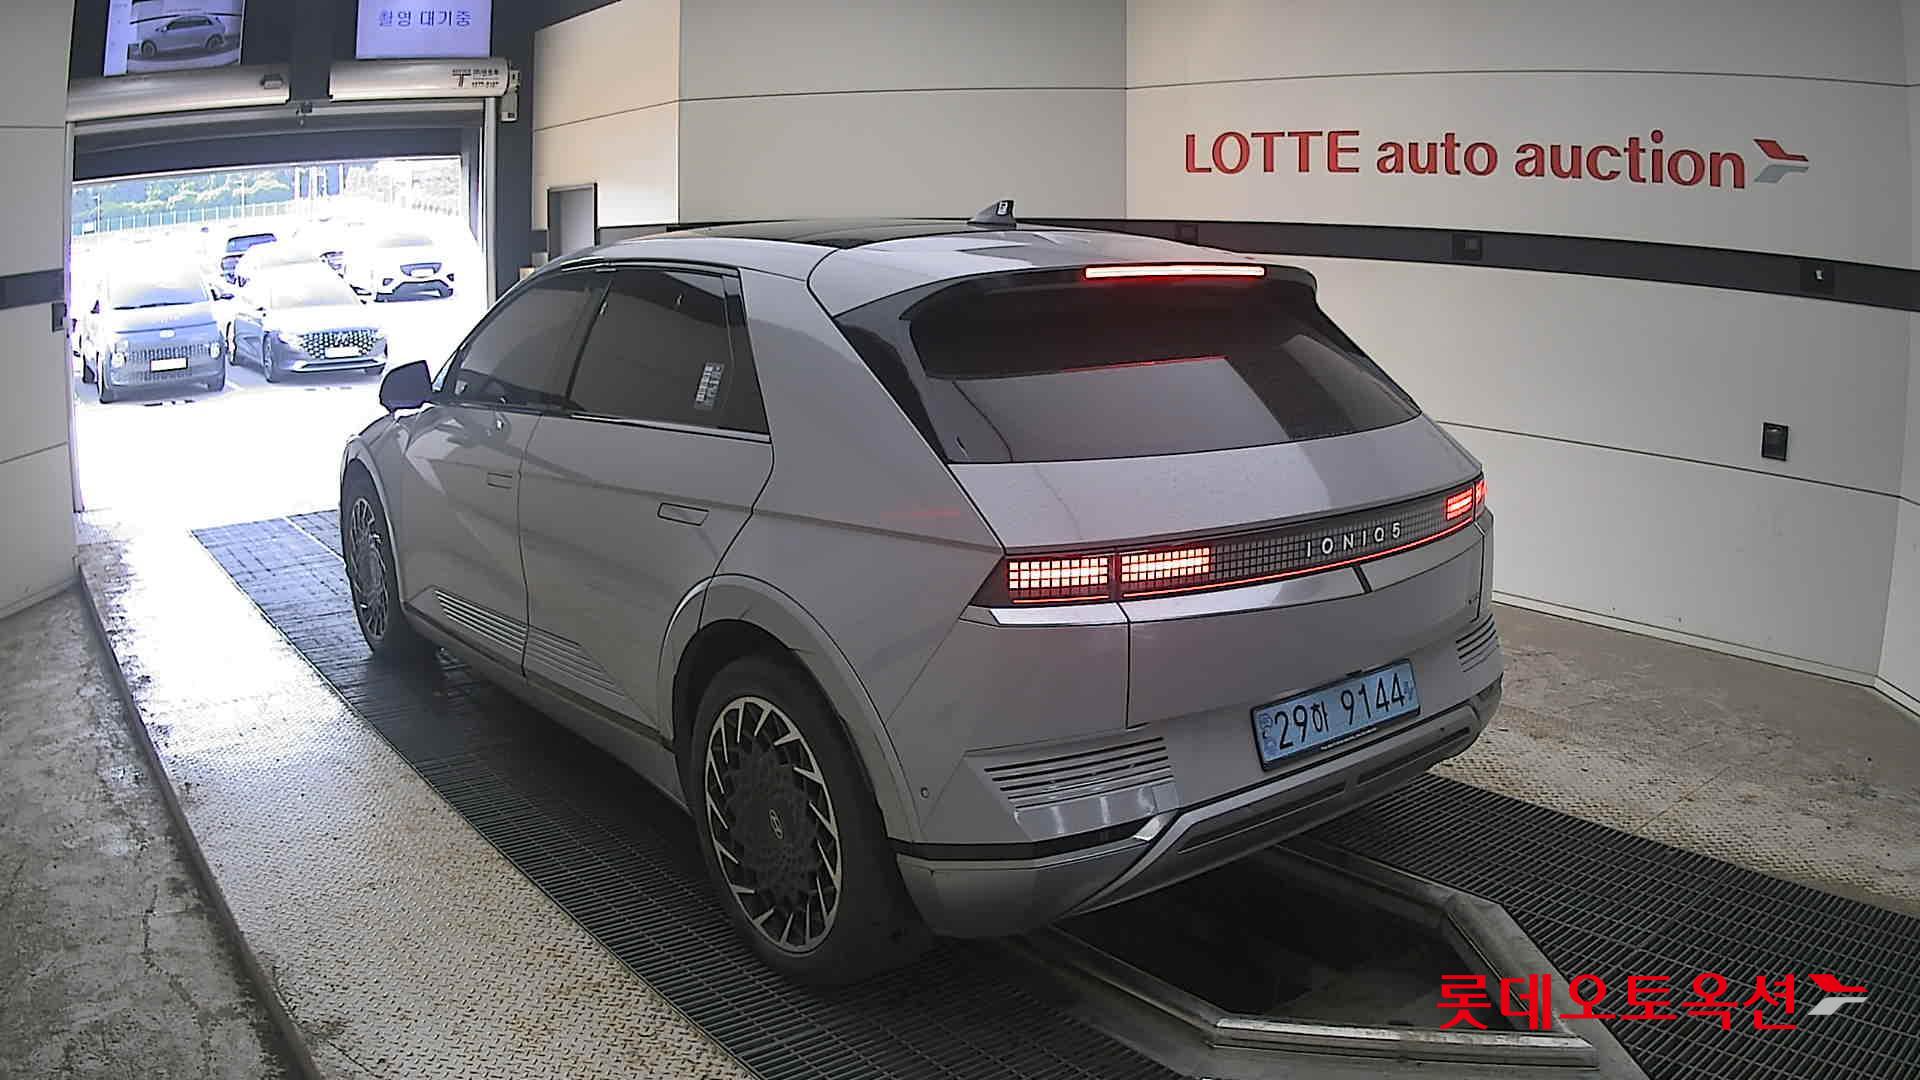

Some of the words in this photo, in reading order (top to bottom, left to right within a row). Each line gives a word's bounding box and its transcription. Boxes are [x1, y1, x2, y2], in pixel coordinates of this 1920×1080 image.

[420, 10, 472, 27] 대기중
[1185, 130, 1360, 174] LOTTE
[1376, 132, 1498, 177] auto
[1514, 129, 1745, 189] auction
[1274, 700, 1329, 750] 29하
[1340, 672, 1406, 726] 9144
